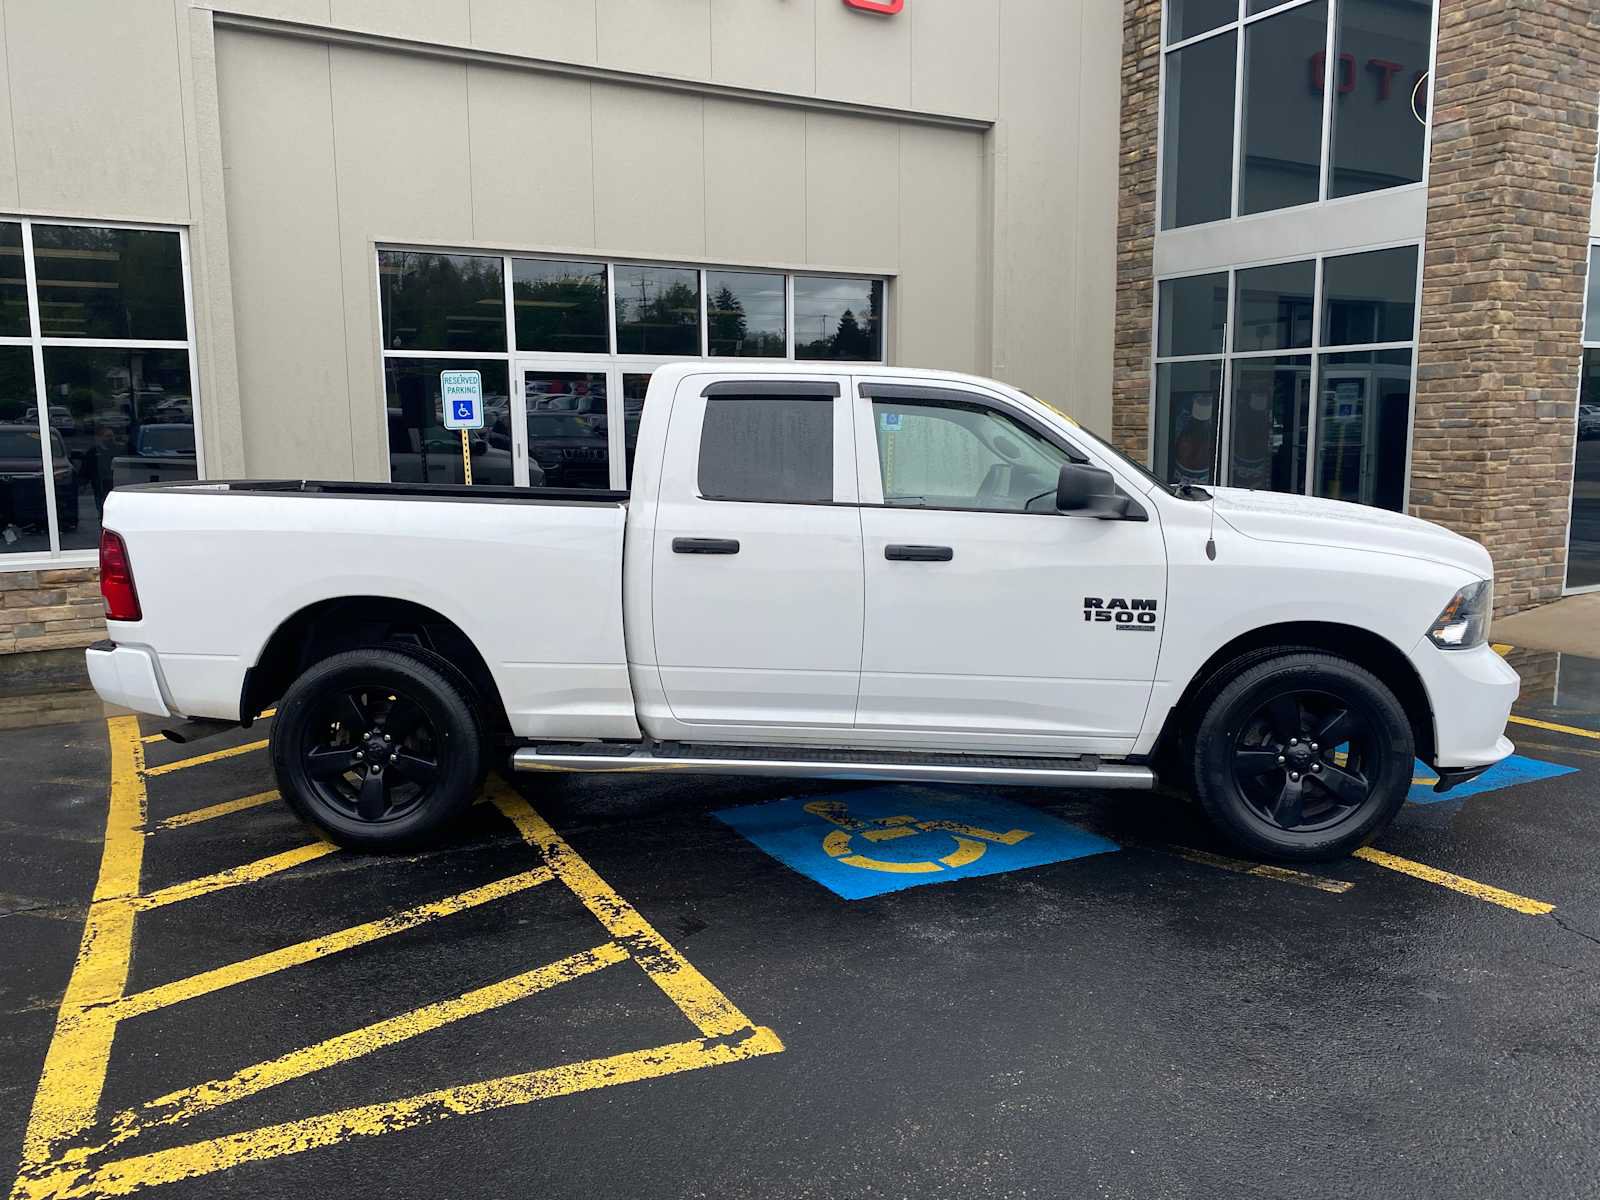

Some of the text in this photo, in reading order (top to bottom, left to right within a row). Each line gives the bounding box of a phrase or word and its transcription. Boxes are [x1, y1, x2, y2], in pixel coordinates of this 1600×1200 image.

[444, 376, 478, 385] RESERVED
[447, 386, 477, 394] PARKING
[1083, 597, 1158, 611] RAM
[1083, 610, 1156, 624] 1500
